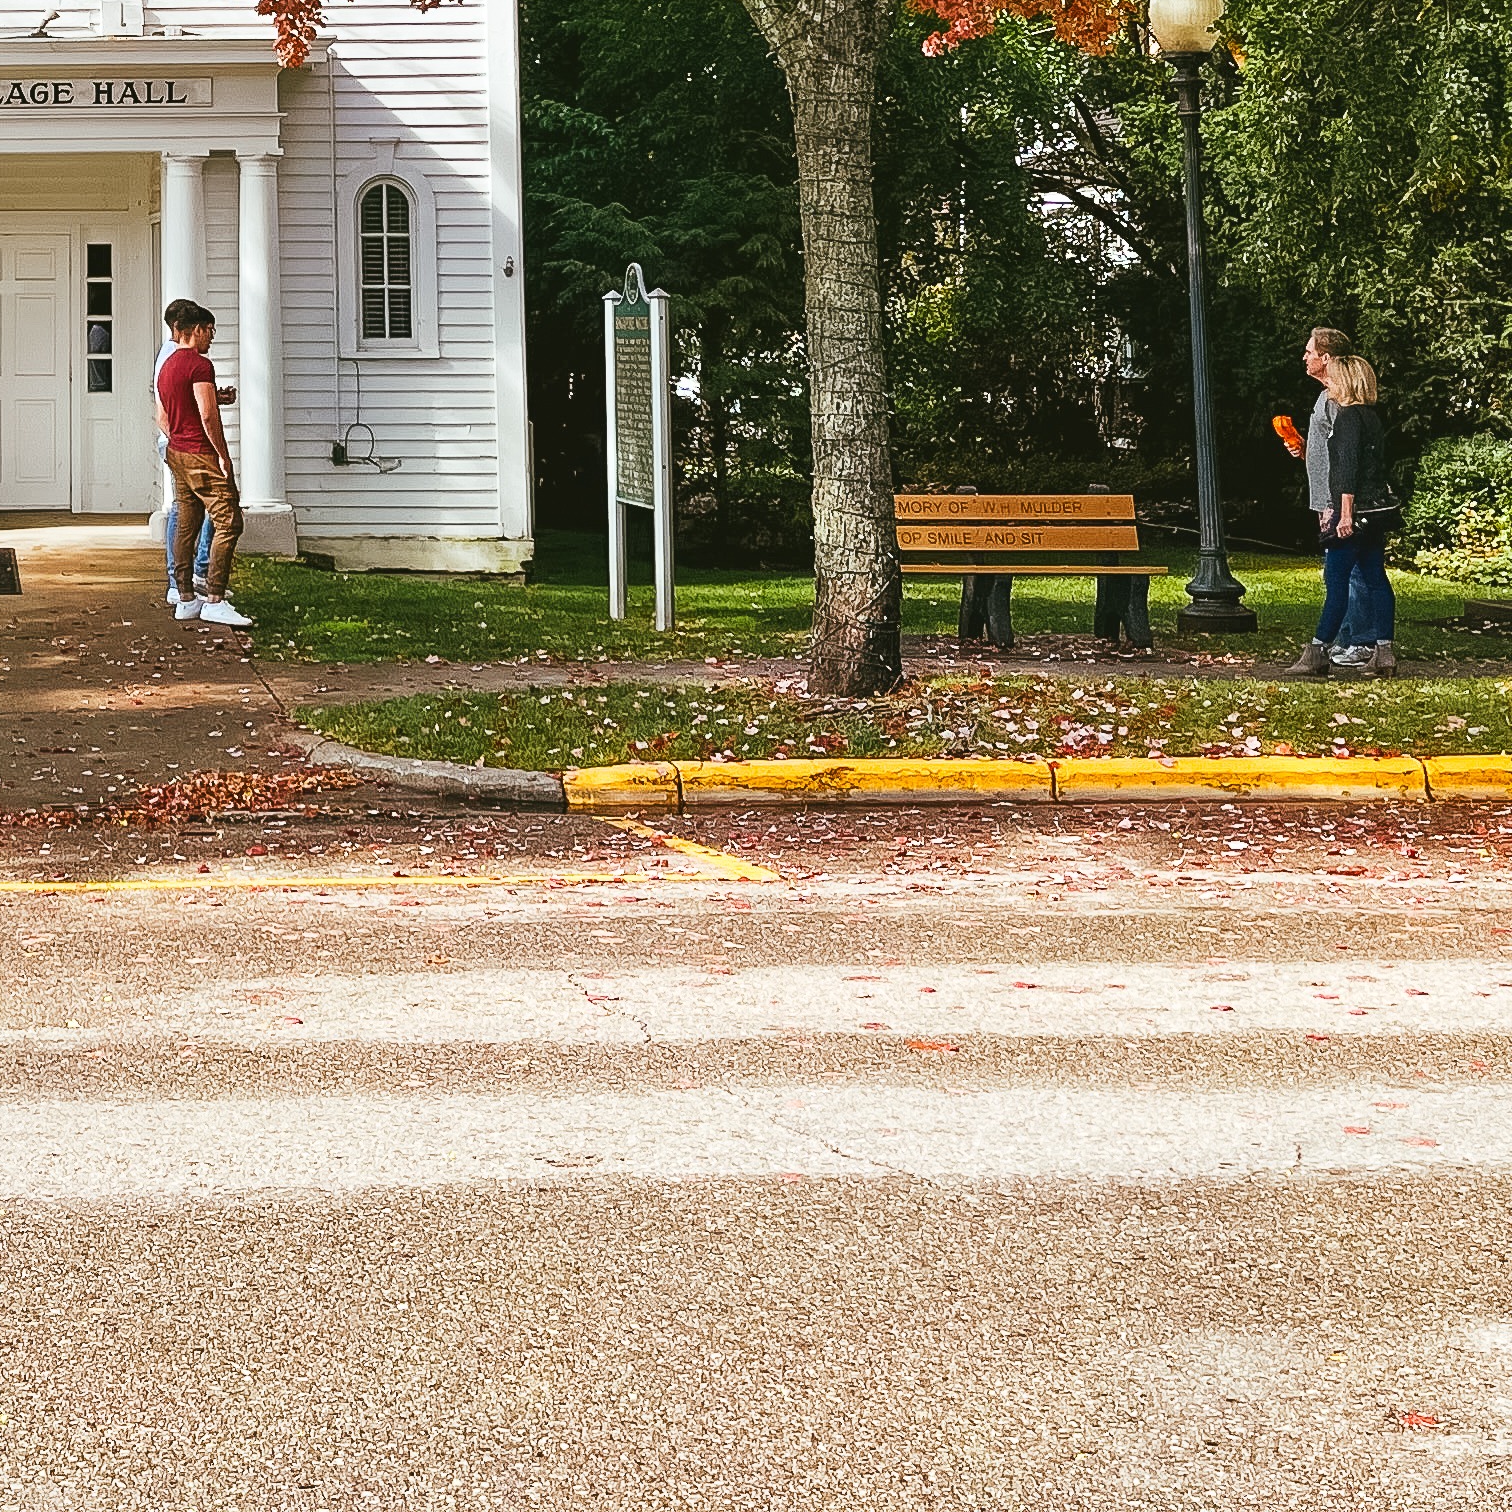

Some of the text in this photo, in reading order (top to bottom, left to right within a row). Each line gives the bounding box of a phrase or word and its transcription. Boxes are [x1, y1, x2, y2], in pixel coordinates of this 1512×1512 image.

[92, 81, 188, 104] HALL
[948, 501, 969, 514] OF
[1020, 500, 1082, 514] MULDER
[927, 531, 972, 545] SMILE
[984, 531, 1015, 545] AND
[1020, 531, 1044, 545] SIT
